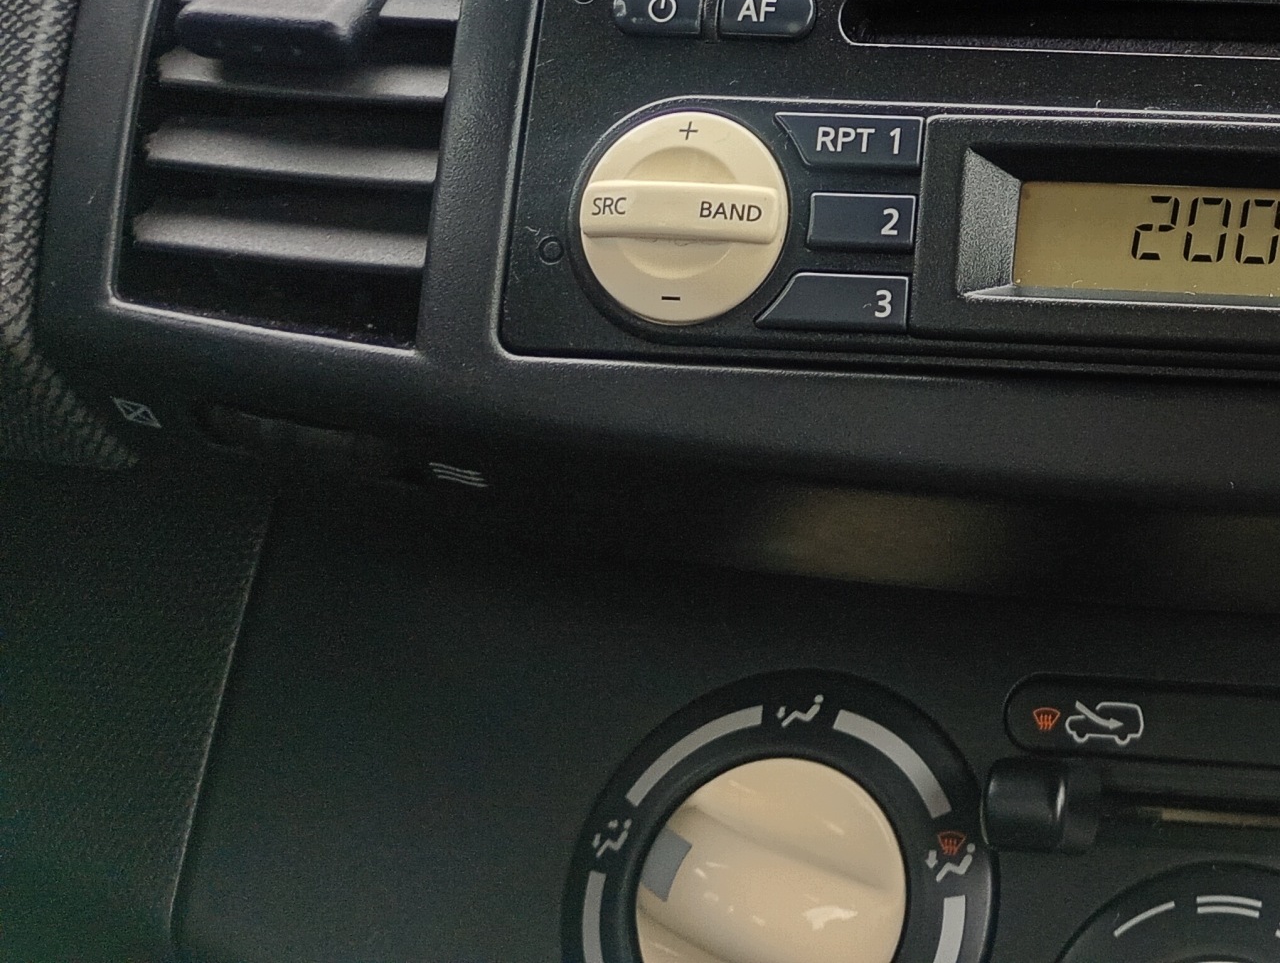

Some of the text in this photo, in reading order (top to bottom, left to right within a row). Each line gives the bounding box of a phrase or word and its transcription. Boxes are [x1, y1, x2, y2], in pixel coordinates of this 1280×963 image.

[816, 126, 902, 154] RPT 1
[591, 196, 763, 222] SRC BAND
[880, 208, 900, 236] 2
[874, 289, 893, 318] 3
